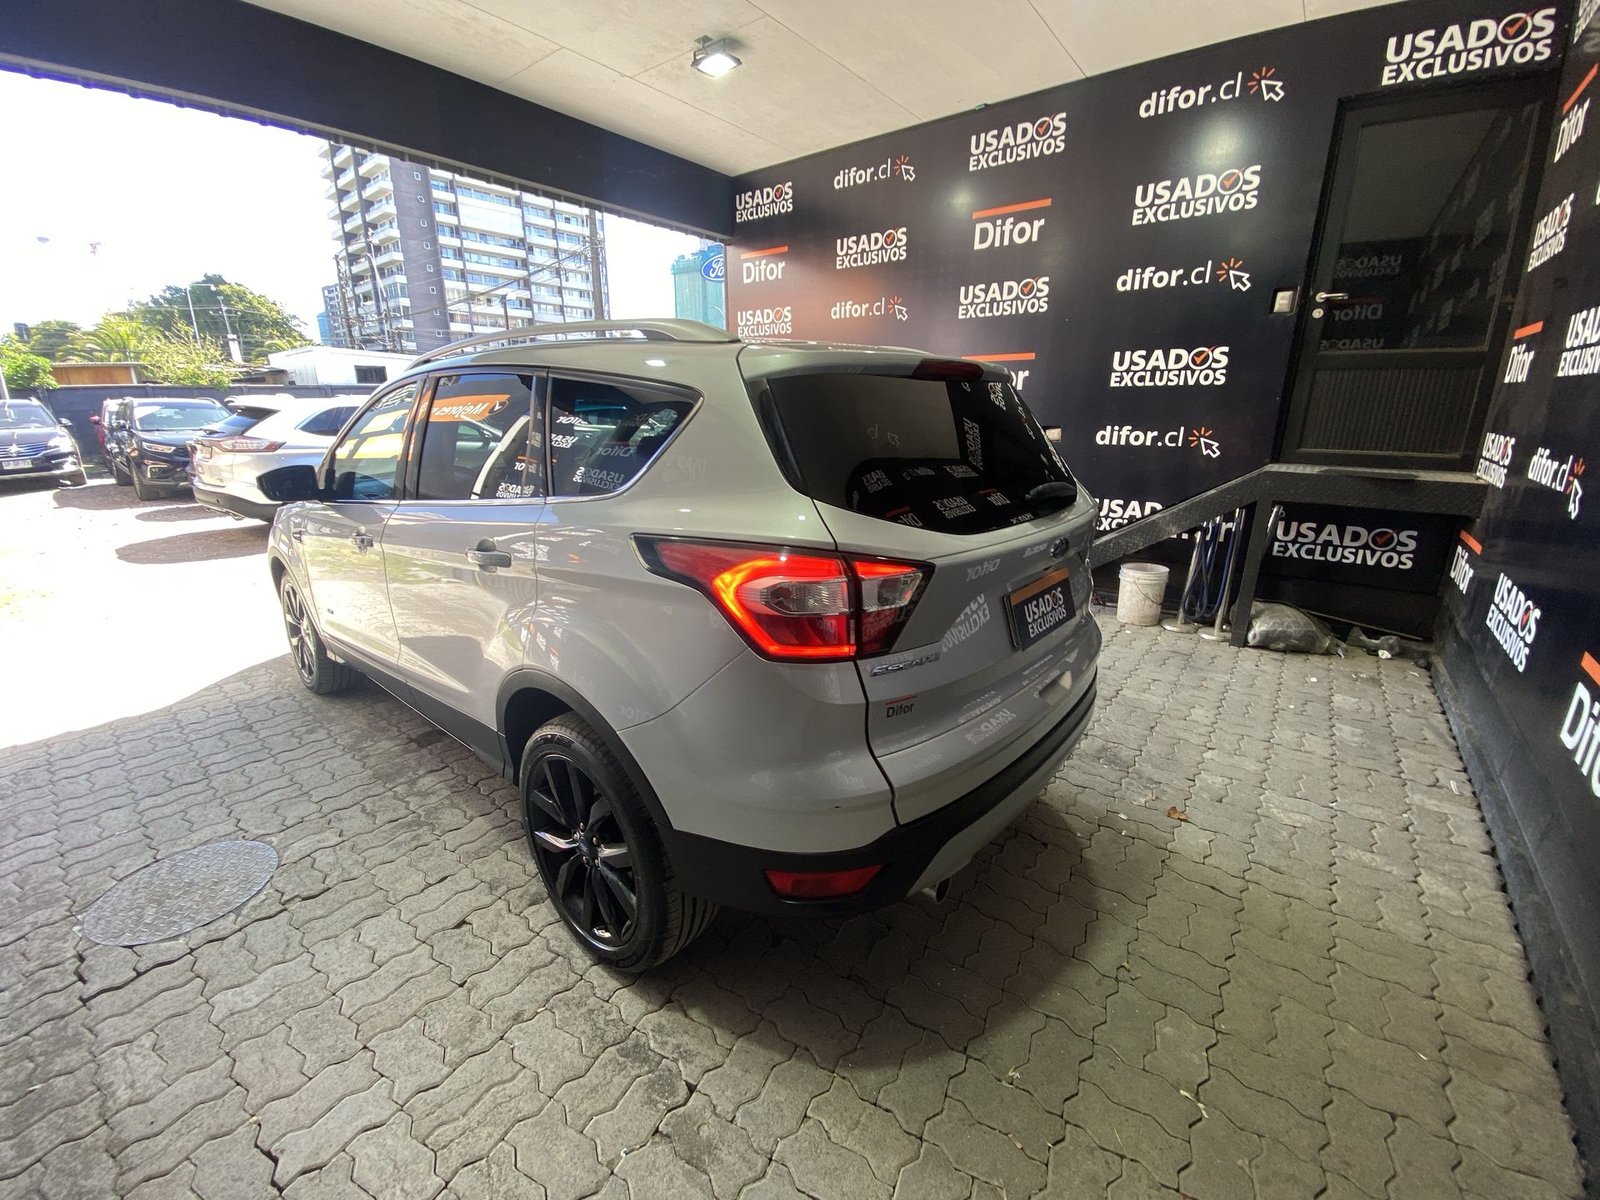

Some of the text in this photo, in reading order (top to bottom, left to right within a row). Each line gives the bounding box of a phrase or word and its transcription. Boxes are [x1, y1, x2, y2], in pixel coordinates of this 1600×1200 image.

[1386, 8, 1556, 63] USADOS
[1381, 38, 1552, 86] EXCLUSIVOS
[1139, 71, 1242, 119] difor.cl
[969, 112, 1066, 155] USADOS
[1554, 97, 1590, 163] Difor
[969, 135, 1065, 171] EXCLUSIVOS
[834, 158, 891, 190] difor.cl
[1134, 165, 1261, 208] USADOS
[735, 181, 793, 210] USADOS
[736, 199, 793, 222] EXCLUSIVOS
[1132, 190, 1258, 226] EXCLUSIVOS
[973, 217, 1045, 250] Difor
[1533, 192, 1575, 249] USADOS
[836, 227, 907, 256] USADOS
[742, 259, 785, 284] Difor
[836, 247, 907, 269] EXCLUSIVOS
[959, 276, 1049, 305] USADOS
[1116, 260, 1212, 292] difor.cl
[737, 306, 792, 326] USADOS
[831, 297, 885, 320] difor.cl
[958, 298, 1048, 319] EXCLUSIVOS
[737, 322, 792, 338] EXCLUSIVOS
[1566, 305, 1600, 349] USAD
[1112, 346, 1229, 372] USADOS
[1504, 343, 1535, 384] Difor
[1110, 369, 1227, 387] EXCLUSIVOS
[1095, 426, 1185, 447] difor.cl
[1482, 431, 1516, 467] USADOS
[1527, 446, 1573, 493] difor.cl
[1094, 498, 1163, 519] USAD
[1275, 521, 1418, 552] USADOS
[1272, 542, 1414, 570] EXCLUSIVOS
[1450, 545, 1474, 595] Difor
[1024, 586, 1064, 624] USADOS
[1493, 572, 1541, 644] USADOS
[1028, 605, 1067, 638] EXCLUSIVOS
[1486, 603, 1530, 673] EXCLUSIVOS
[886, 703, 914, 718] Difor
